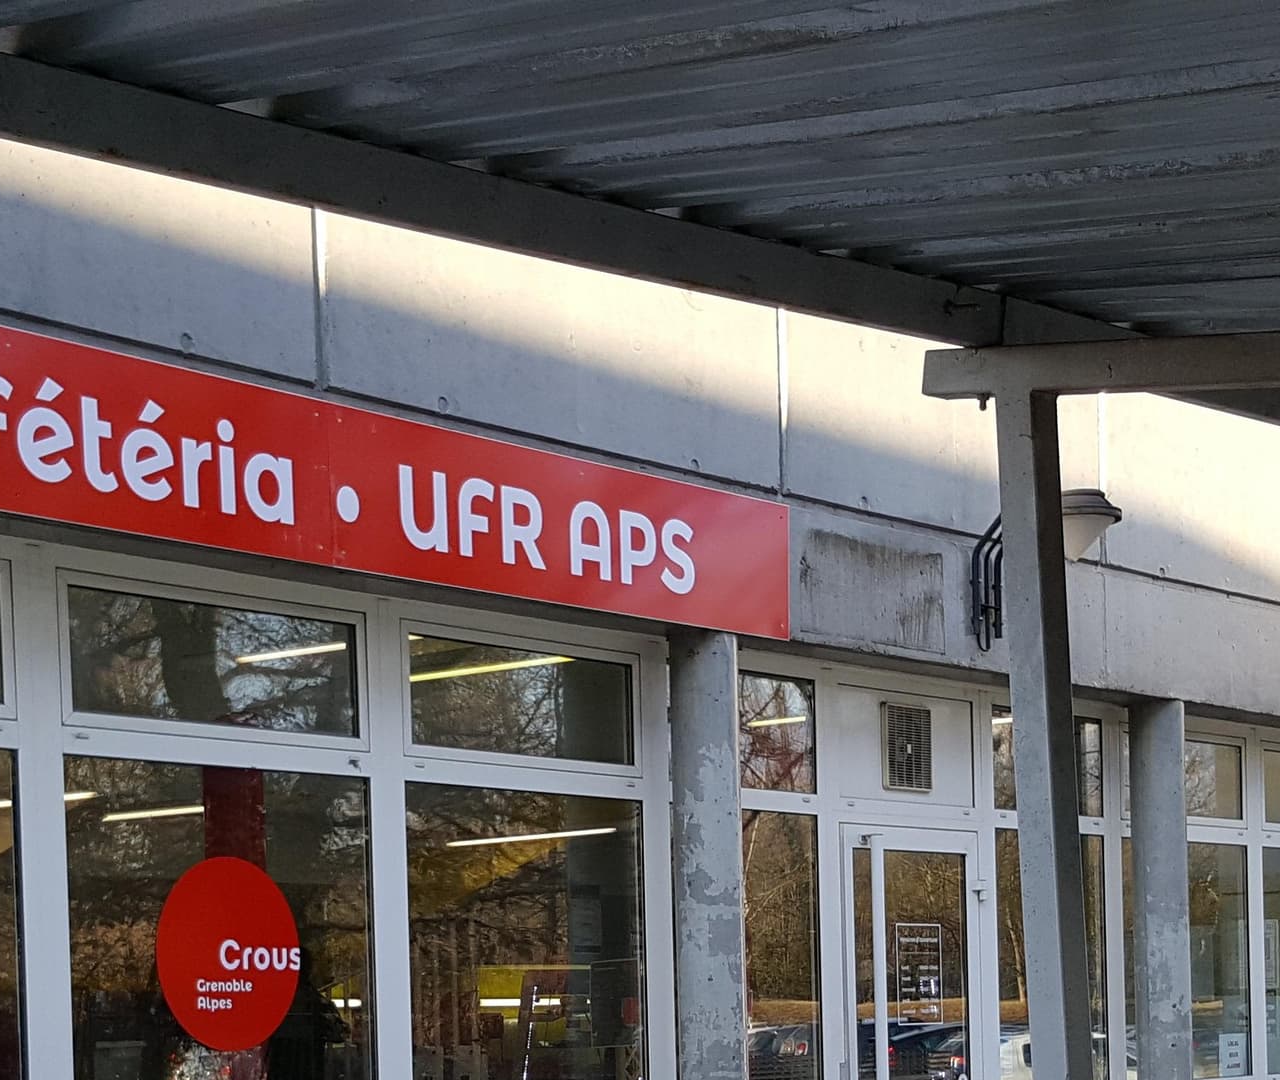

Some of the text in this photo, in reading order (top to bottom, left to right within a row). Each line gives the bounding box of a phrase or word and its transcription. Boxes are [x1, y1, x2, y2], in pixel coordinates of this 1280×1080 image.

[398, 463, 547, 571] UFR
[569, 500, 696, 595] APS
[219, 938, 301, 971] Crous
[197, 979, 253, 993] Grenoble
[197, 996, 233, 1012] Alpes
